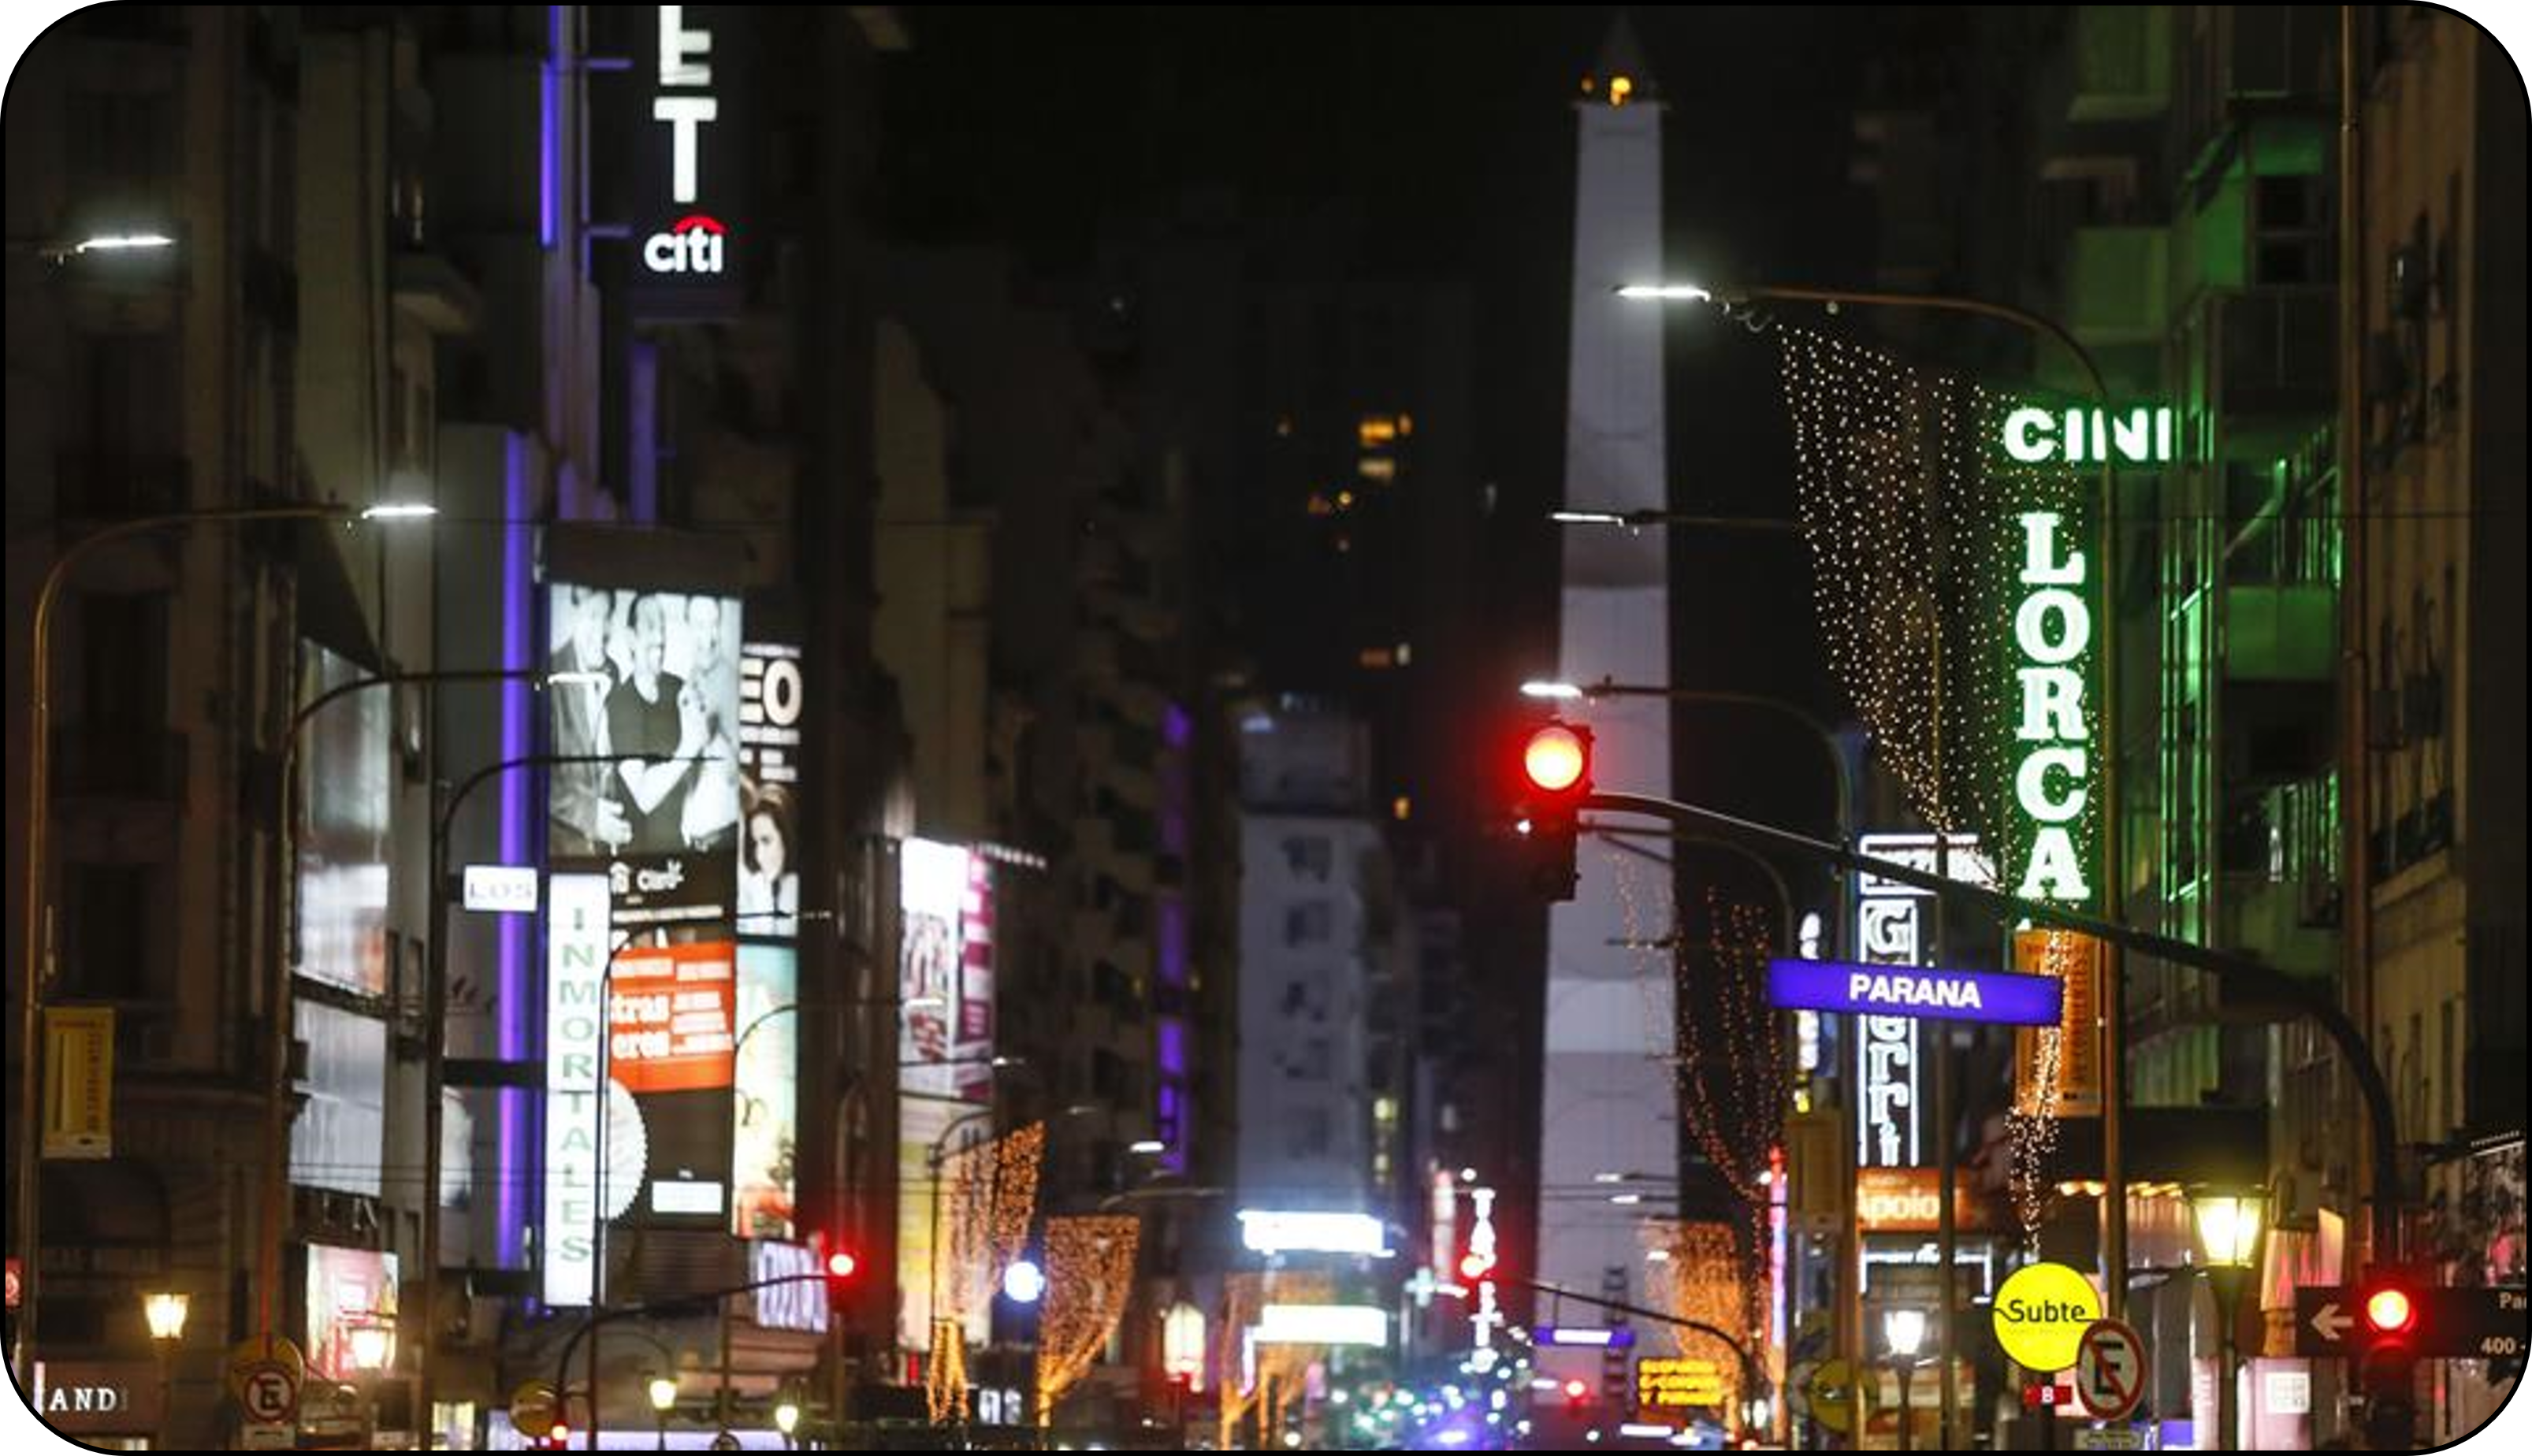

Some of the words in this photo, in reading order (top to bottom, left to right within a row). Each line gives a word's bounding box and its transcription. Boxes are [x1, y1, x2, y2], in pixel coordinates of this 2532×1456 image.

[644, 225, 723, 273] citi
[2015, 511, 2091, 900] LORCA
[1849, 973, 1982, 1008] PARANA
[559, 907, 597, 1263] INMORTALES
[2009, 1299, 2087, 1323] Subte
[2481, 1336, 2516, 1355] 400
[49, 1388, 117, 1411] AND
